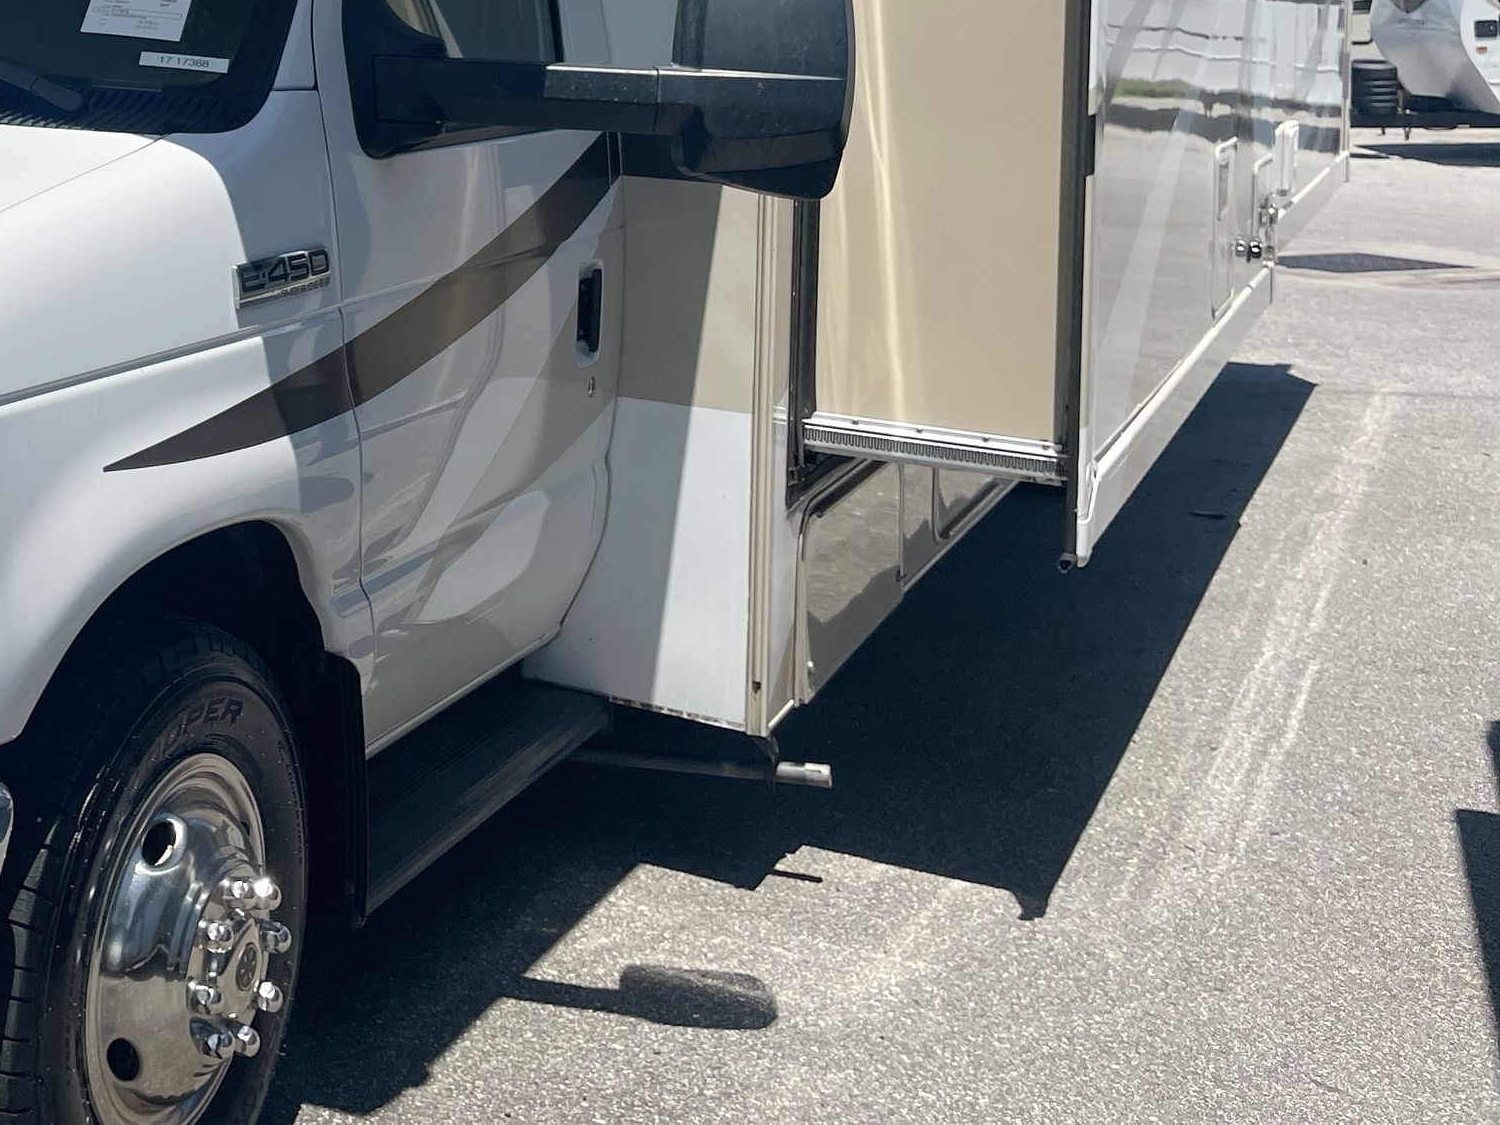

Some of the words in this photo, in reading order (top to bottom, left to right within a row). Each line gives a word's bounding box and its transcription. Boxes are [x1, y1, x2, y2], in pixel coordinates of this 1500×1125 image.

[160, 56, 172, 65] 17
[177, 57, 209, 68] 17368
[242, 249, 330, 293] E-450
